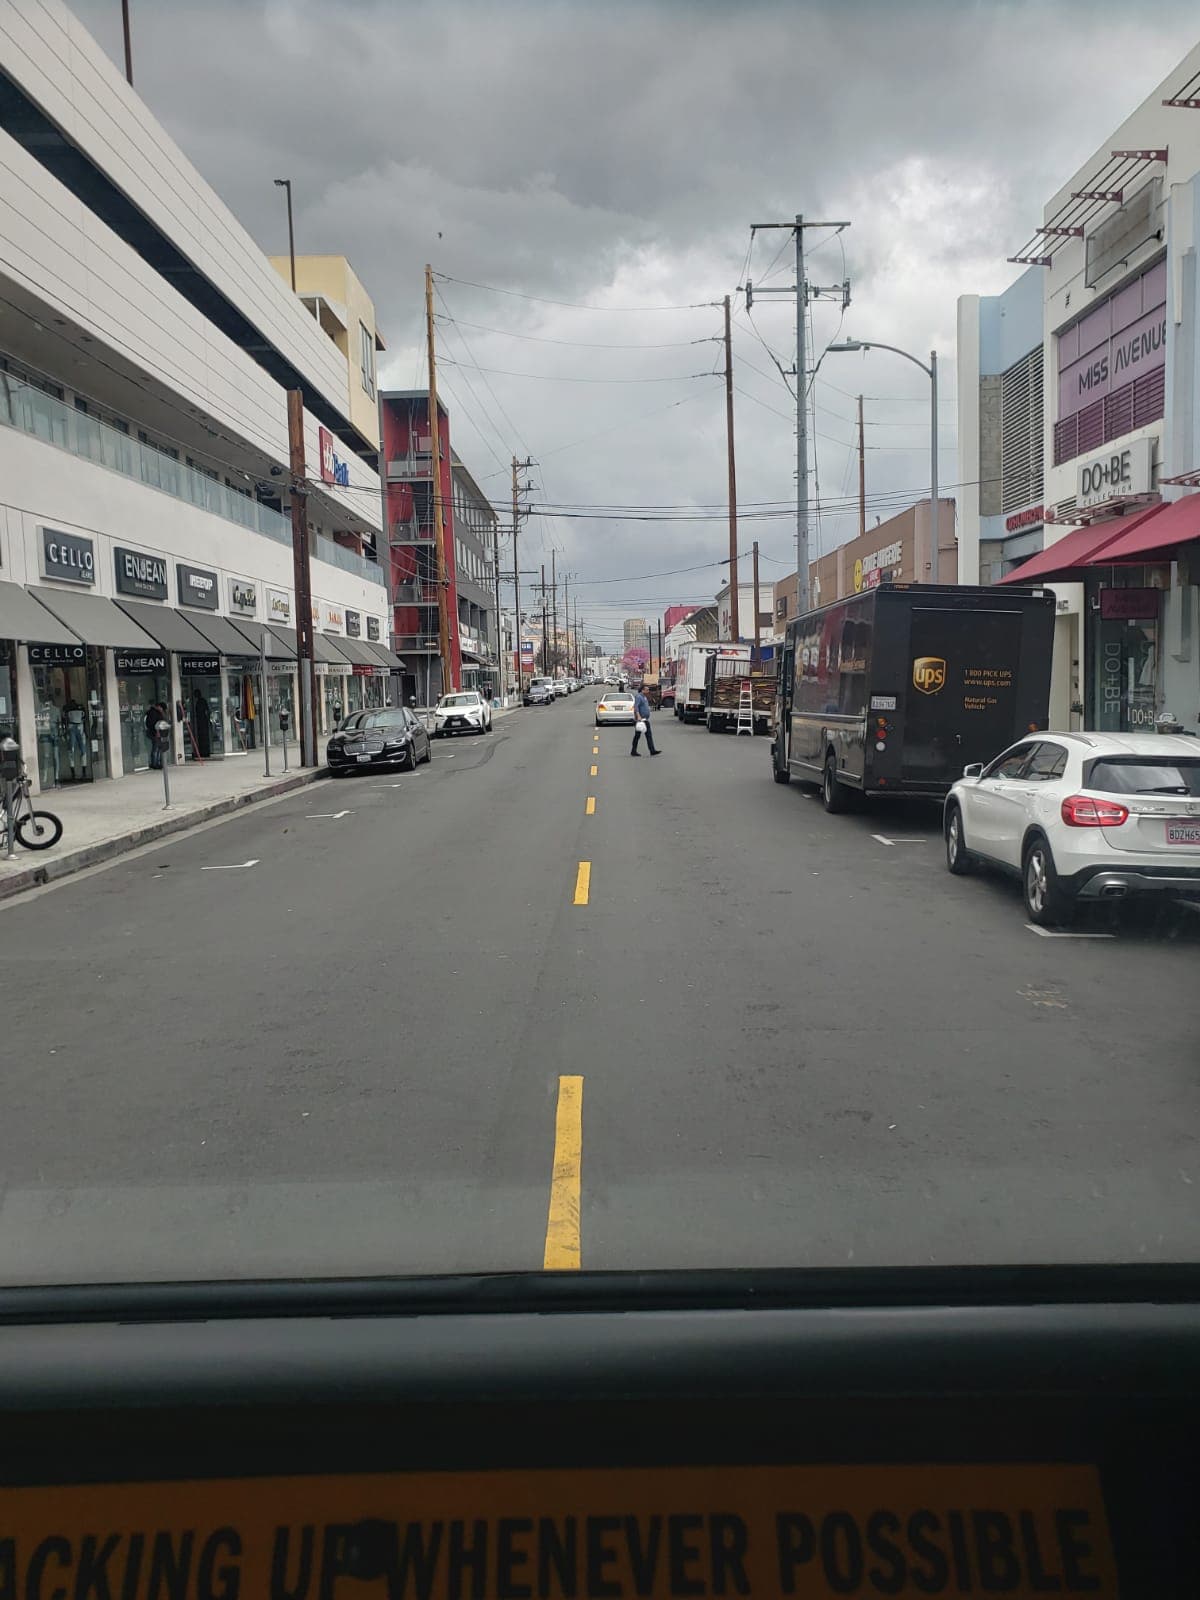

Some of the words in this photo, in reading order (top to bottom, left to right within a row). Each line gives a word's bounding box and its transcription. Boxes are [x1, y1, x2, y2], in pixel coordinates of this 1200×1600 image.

[1078, 356, 1109, 396] MISS
[1081, 449, 1131, 496] DO+BE
[49, 543, 94, 570] CELLO
[31, 648, 84, 658] CELLO
[915, 668, 943, 689] ups
[1104, 642, 1121, 714] DO+BE
[386, 1514, 751, 1600] WHENEVER
[775, 1508, 1101, 1594] POSSIBLE
